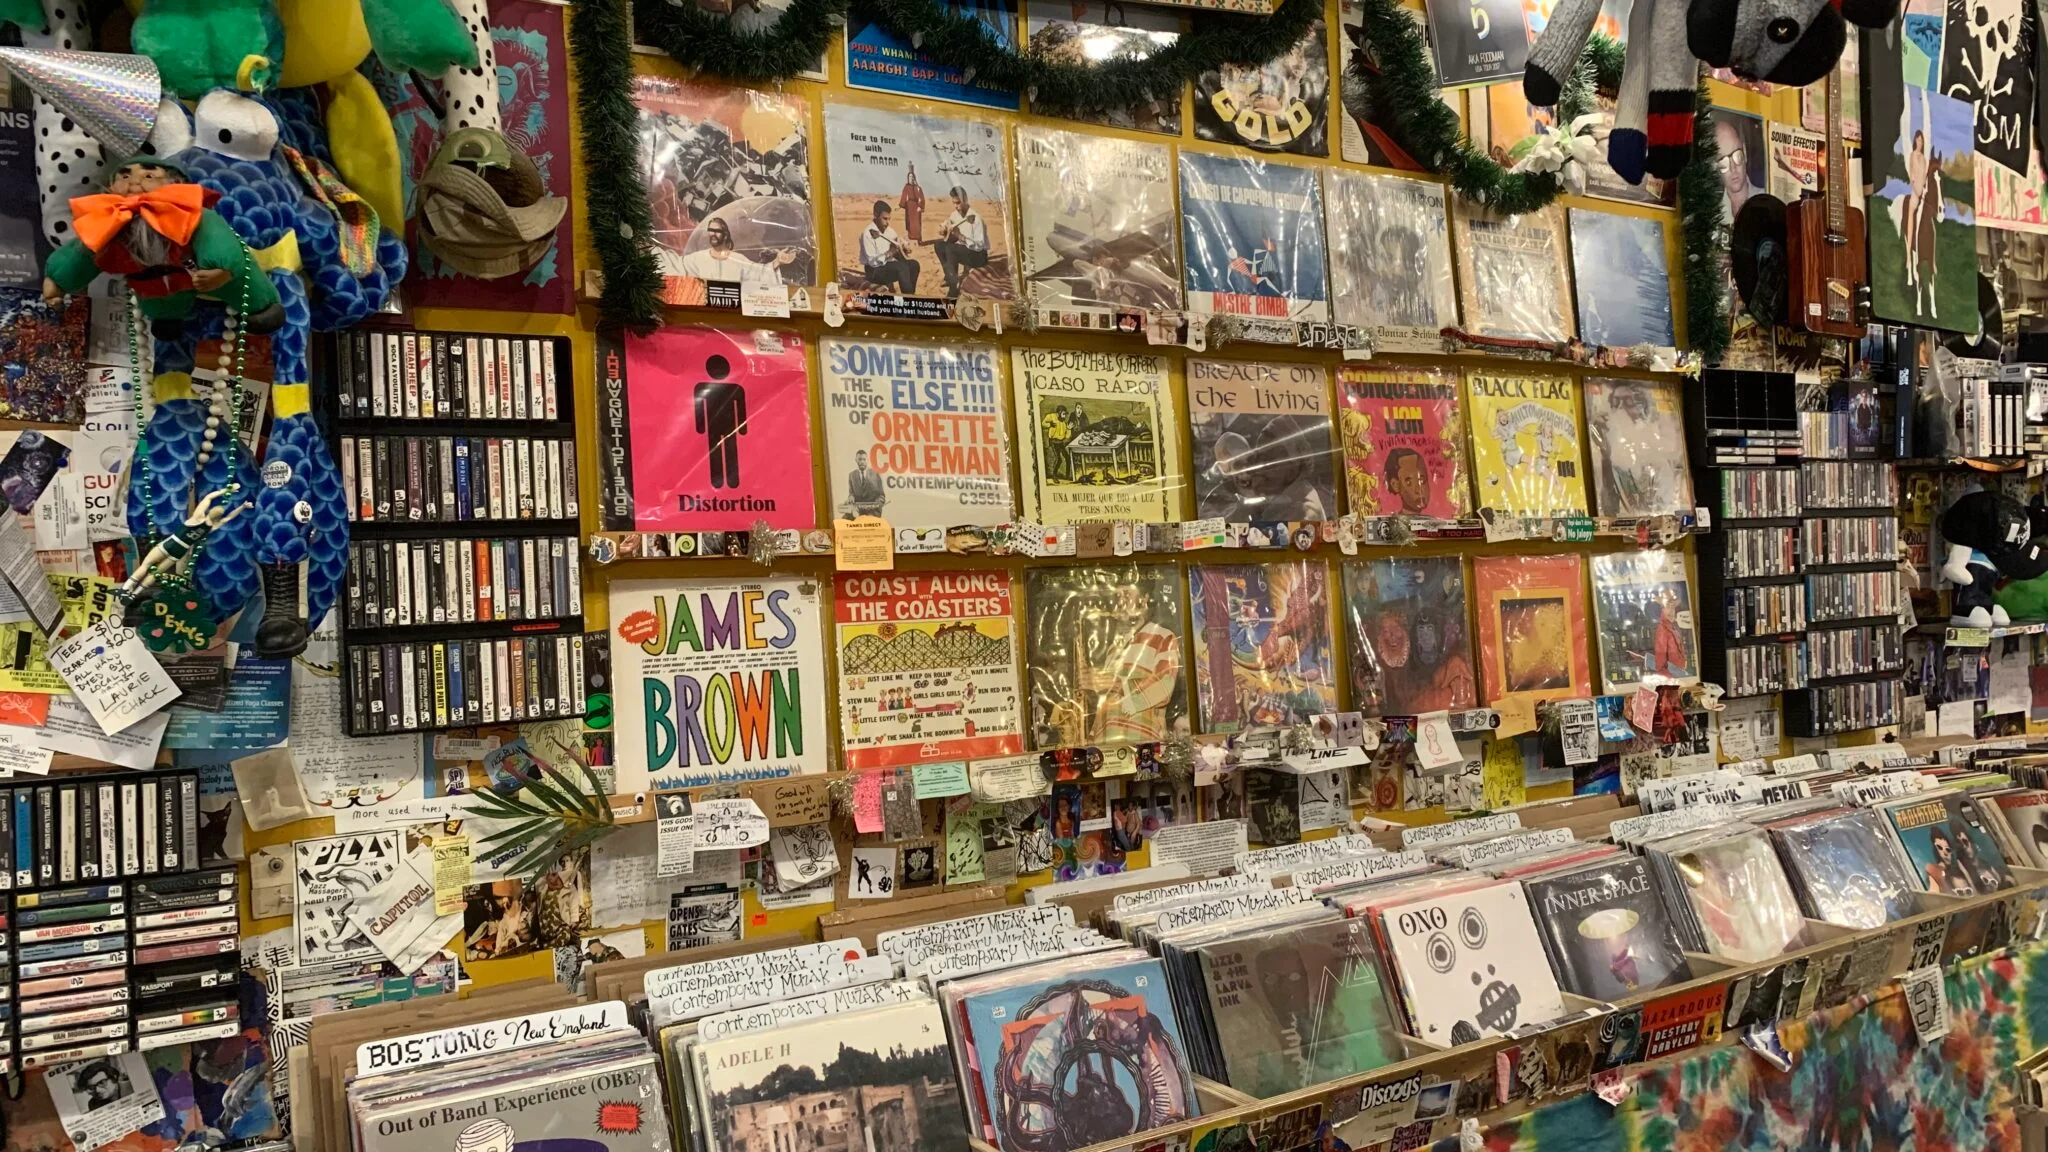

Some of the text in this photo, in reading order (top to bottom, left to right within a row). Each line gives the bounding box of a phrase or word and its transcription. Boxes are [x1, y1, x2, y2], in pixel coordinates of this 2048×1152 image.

[881, 47, 917, 60] WHAM!
[1468, 51, 1504, 65] AKA FOODMAN
[852, 58, 939, 81] AAARGH! BAP!
[1212, 86, 1313, 145] GOLD
[850, 132, 896, 145] Face to Face
[1771, 131, 1816, 150] SOUND EFFECTS
[852, 154, 899, 166] M. MATAR
[1791, 159, 1816, 171] FIREPOWER
[1256, 295, 1289, 317] BIMBA
[406, 340, 417, 398] URIAH HEEP
[829, 344, 993, 384] SOMETHING
[843, 377, 996, 414] THE ELSE!!!!
[1472, 378, 1570, 400] BLACK FLAG
[831, 391, 885, 411] MUSIC
[848, 409, 999, 447] OF ORNETTE
[1383, 406, 1425, 435] LION
[869, 443, 1001, 476] COLEMAN
[568, 477, 576, 498] PARTON
[886, 475, 1001, 491] CONTEMPORARY
[677, 493, 777, 513] Distortion
[1078, 503, 1132, 515] TRES NIÑOS
[1567, 527, 1593, 541] No Jalopy
[434, 544, 440, 552] ZZ
[844, 574, 1000, 597] COAST ALONG
[93, 582, 109, 616] POP
[846, 597, 1002, 622] THE COASTERS
[154, 602, 208, 647] DEXYS
[640, 588, 797, 656] JAMES
[50, 641, 82, 662] TEES
[94, 613, 123, 638] $10
[62, 626, 135, 677] SCARVES $20
[434, 650, 442, 672] ZYDECO
[74, 653, 121, 682] ALL HAND
[75, 660, 124, 692] DYED BY
[98, 671, 151, 712] LAURIE
[436, 692, 444, 710] PARTY
[643, 668, 804, 772] BROWN
[859, 715, 896, 724] LITTLE EGYPT
[1884, 758, 1897, 767] TEN
[1898, 758, 1906, 767] OF
[1911, 757, 1927, 766] KIND
[1705, 787, 1742, 805] PUNK
[1762, 782, 1805, 805] METAL
[353, 804, 442, 820] more used tapes
[674, 817, 693, 826] GODS
[660, 824, 694, 834] ISSUE ONE
[1296, 854, 1394, 888] Contemporary Muzak
[304, 893, 348, 906] New Pope
[308, 887, 348, 895] Massagers
[1543, 874, 1650, 916] INNER SPACE
[370, 883, 430, 937] CAPITOL
[670, 906, 700, 922] OPENS
[1157, 891, 1279, 932] Contemporary Muzak
[36, 924, 91, 938] VAN MORRISON
[670, 923, 698, 938] GATES
[1399, 906, 1448, 937] ONO
[1916, 915, 1946, 932] NEVER
[1913, 928, 1945, 948] FORGET
[930, 934, 1065, 976] Contemporary Muzak
[1209, 953, 1244, 969] LIZZO
[762, 959, 806, 980] Muzak
[140, 981, 174, 992] PASSPORT
[672, 968, 829, 1016] Contemporary Muzak
[1215, 980, 1253, 995] LARVA
[1218, 993, 1241, 1009] INK
[1643, 993, 1723, 1029] HAZARDOUS
[703, 997, 828, 1041] Contemporary
[834, 985, 884, 1013] Muzak
[53, 1028, 103, 1041] VAN MORRISON
[367, 1030, 482, 1069] BOSTON
[505, 1018, 547, 1045] New
[549, 1010, 611, 1039] England
[1654, 1020, 1700, 1042] DESTROY
[1651, 1033, 1698, 1056] BABYLON
[43, 1051, 83, 1062] SIMPLY RED
[717, 1042, 791, 1071] ADELE H
[48, 1063, 73, 1077] DEEP
[378, 1070, 643, 1137] Out of Band Experience (OBE)
[1359, 1074, 1421, 1112] Discogs
